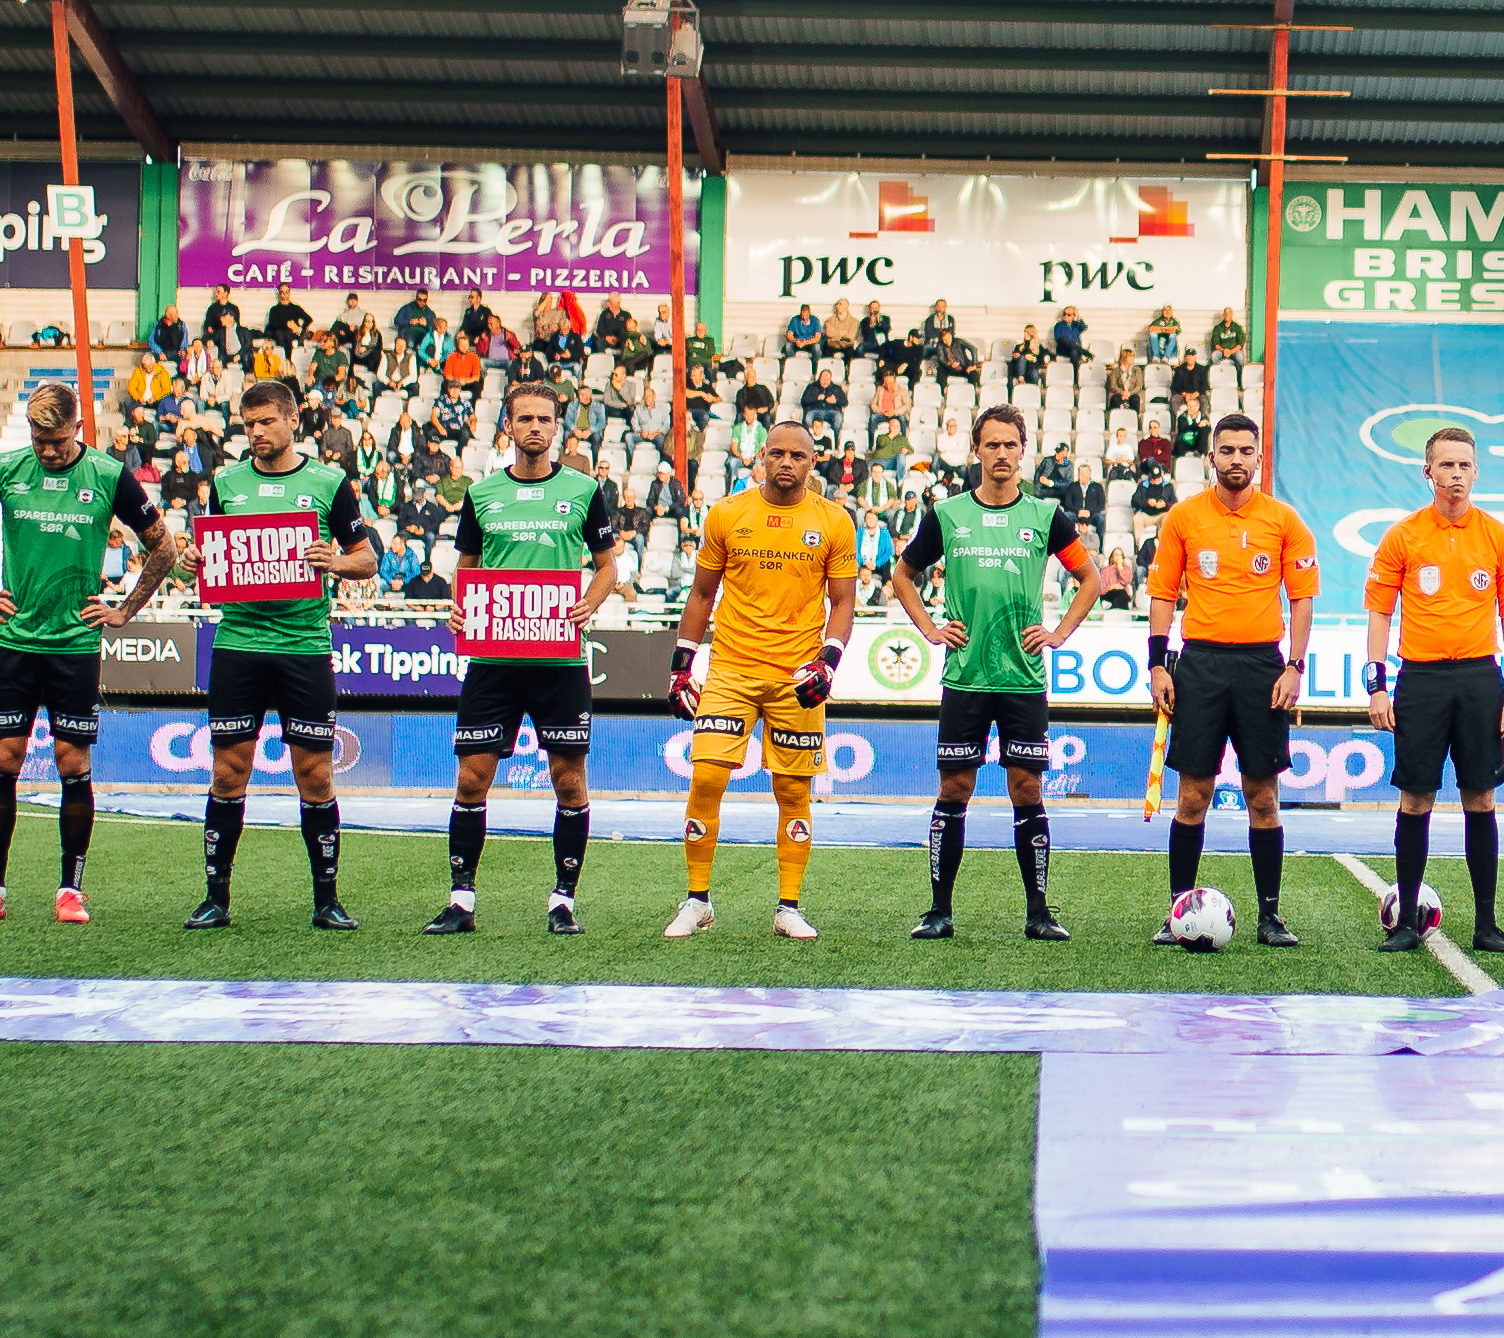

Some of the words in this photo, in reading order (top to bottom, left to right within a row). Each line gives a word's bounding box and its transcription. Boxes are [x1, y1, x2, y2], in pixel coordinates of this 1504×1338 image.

[54, 192, 86, 228] B
[231, 189, 378, 258] La
[380, 170, 651, 259] Perla
[324, 263, 498, 286] RESTAURANT
[530, 267, 651, 289] PIZZERIA
[778, 253, 894, 298] pwc
[1039, 259, 1155, 303] pwc
[13, 509, 94, 525] SPAREBANKEN
[39, 522, 64, 534] SØR
[483, 520, 568, 533] SPAREBANKEN
[511, 530, 536, 542] SØR
[731, 547, 814, 562] SPAREBANKEN
[952, 546, 1031, 560] SPAREBANKEN
[758, 561, 783, 571] SØR
[978, 559, 1002, 569] SØR
[230, 559, 316, 586] RASISMEN
[491, 617, 577, 642] RASISMEN
[694, 717, 742, 732] MASIV
[455, 728, 499, 741] MASIV
[542, 729, 589, 741] MASIV
[773, 731, 822, 747] MASIV
